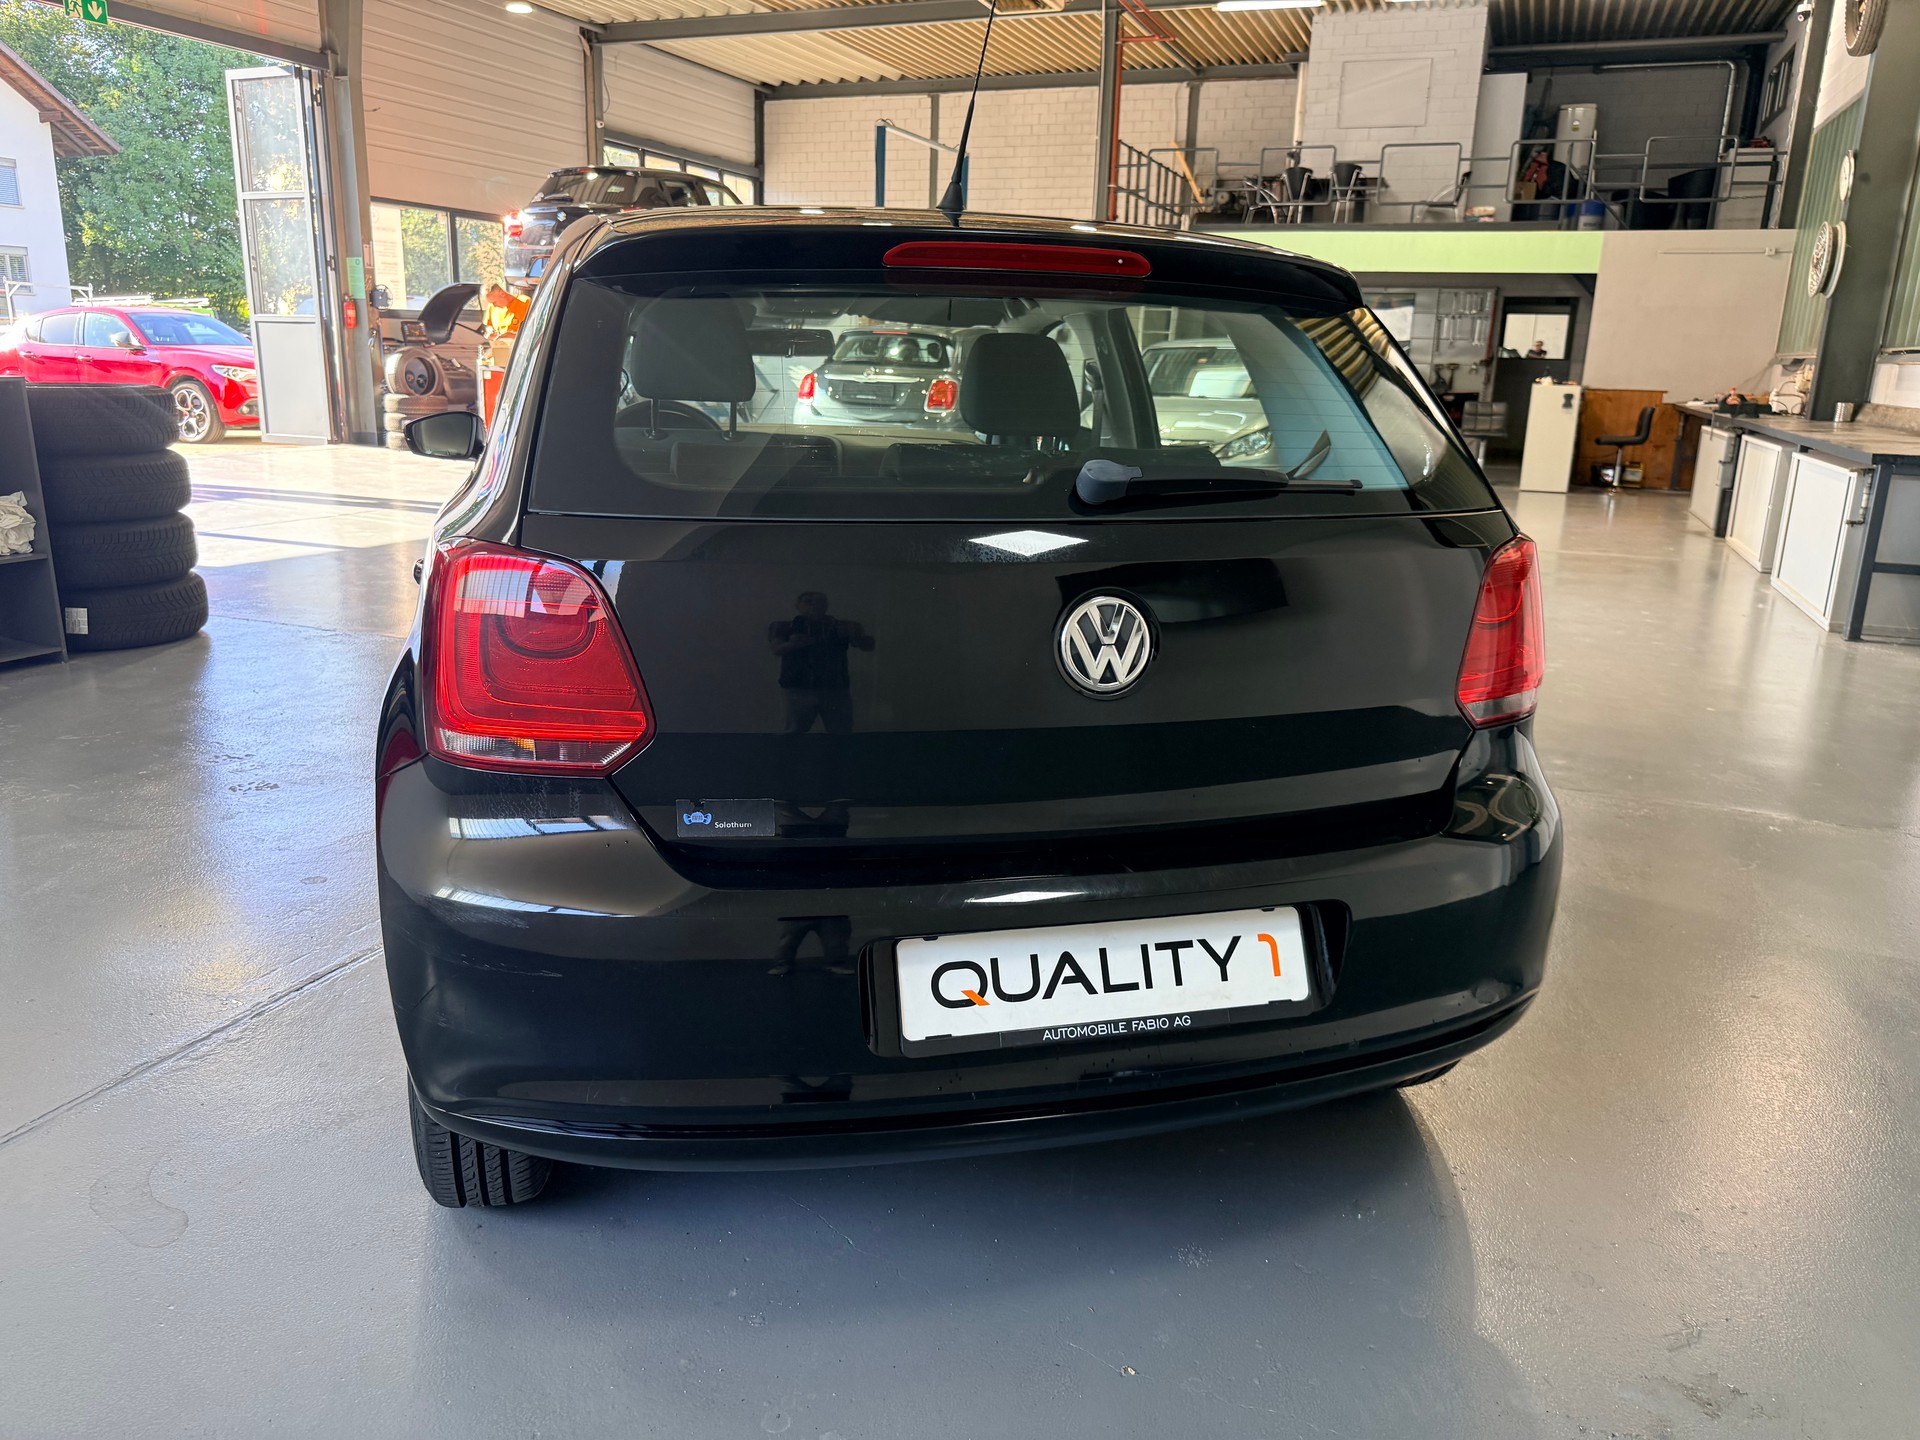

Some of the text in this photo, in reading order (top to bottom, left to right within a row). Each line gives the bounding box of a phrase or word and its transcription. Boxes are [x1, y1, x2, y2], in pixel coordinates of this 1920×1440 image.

[1066, 600, 1146, 686] VW
[714, 821, 752, 829] Solothurn
[930, 935, 1242, 1009] QUALITY
[1042, 1015, 1192, 1041] AUTOMOBILE FABIO AG
